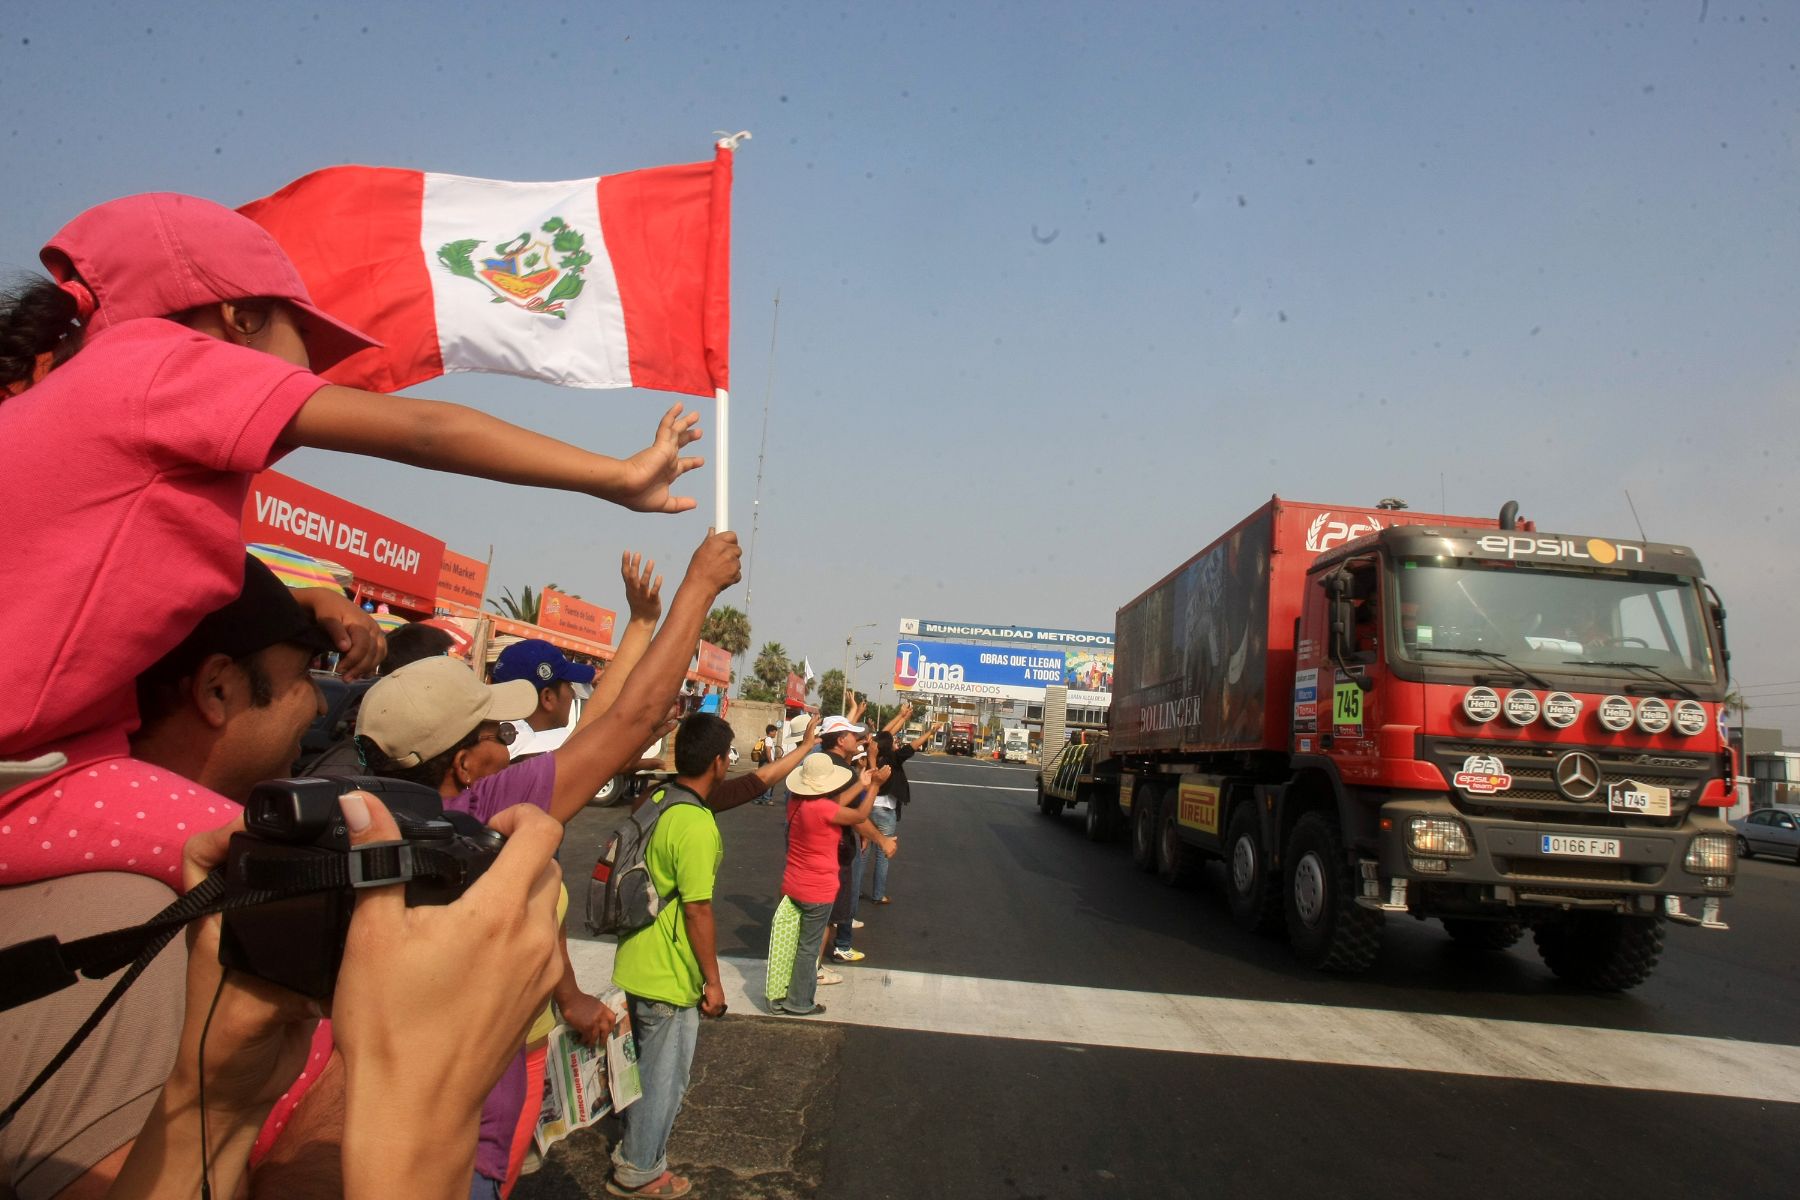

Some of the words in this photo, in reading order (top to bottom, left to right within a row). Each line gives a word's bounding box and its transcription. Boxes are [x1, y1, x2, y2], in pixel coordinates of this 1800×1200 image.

[255, 491, 335, 546] VIRGEN
[336, 522, 370, 559] DEL
[373, 537, 421, 574] CHAPI
[452, 563, 476, 580] Market
[926, 624, 1034, 639] MUNICIPALIDAD
[1037, 631, 1115, 645] METROPOL
[899, 650, 965, 683] Lima
[980, 653, 1009, 666] OBRAS
[1010, 655, 1027, 668] QUE
[1028, 657, 1061, 670] LLEGAN
[1024, 670, 1031, 680] A
[1032, 669, 1060, 681] TODOS
[1336, 690, 1359, 718] 745
[1470, 700, 1496, 708] Hella
[1510, 702, 1535, 711] Hella
[1549, 705, 1574, 714] Hella
[1605, 708, 1630, 717] Hella
[1140, 695, 1201, 733] BOLLINGER
[1643, 710, 1667, 719] Hella
[1679, 713, 1703, 722] Hella
[1181, 788, 1216, 827] PIRELLI
[1627, 794, 1646, 807] 745
[1552, 838, 1586, 853] 0166
[1590, 840, 1616, 855] FJR
[577, 1094, 587, 1122] Franco
